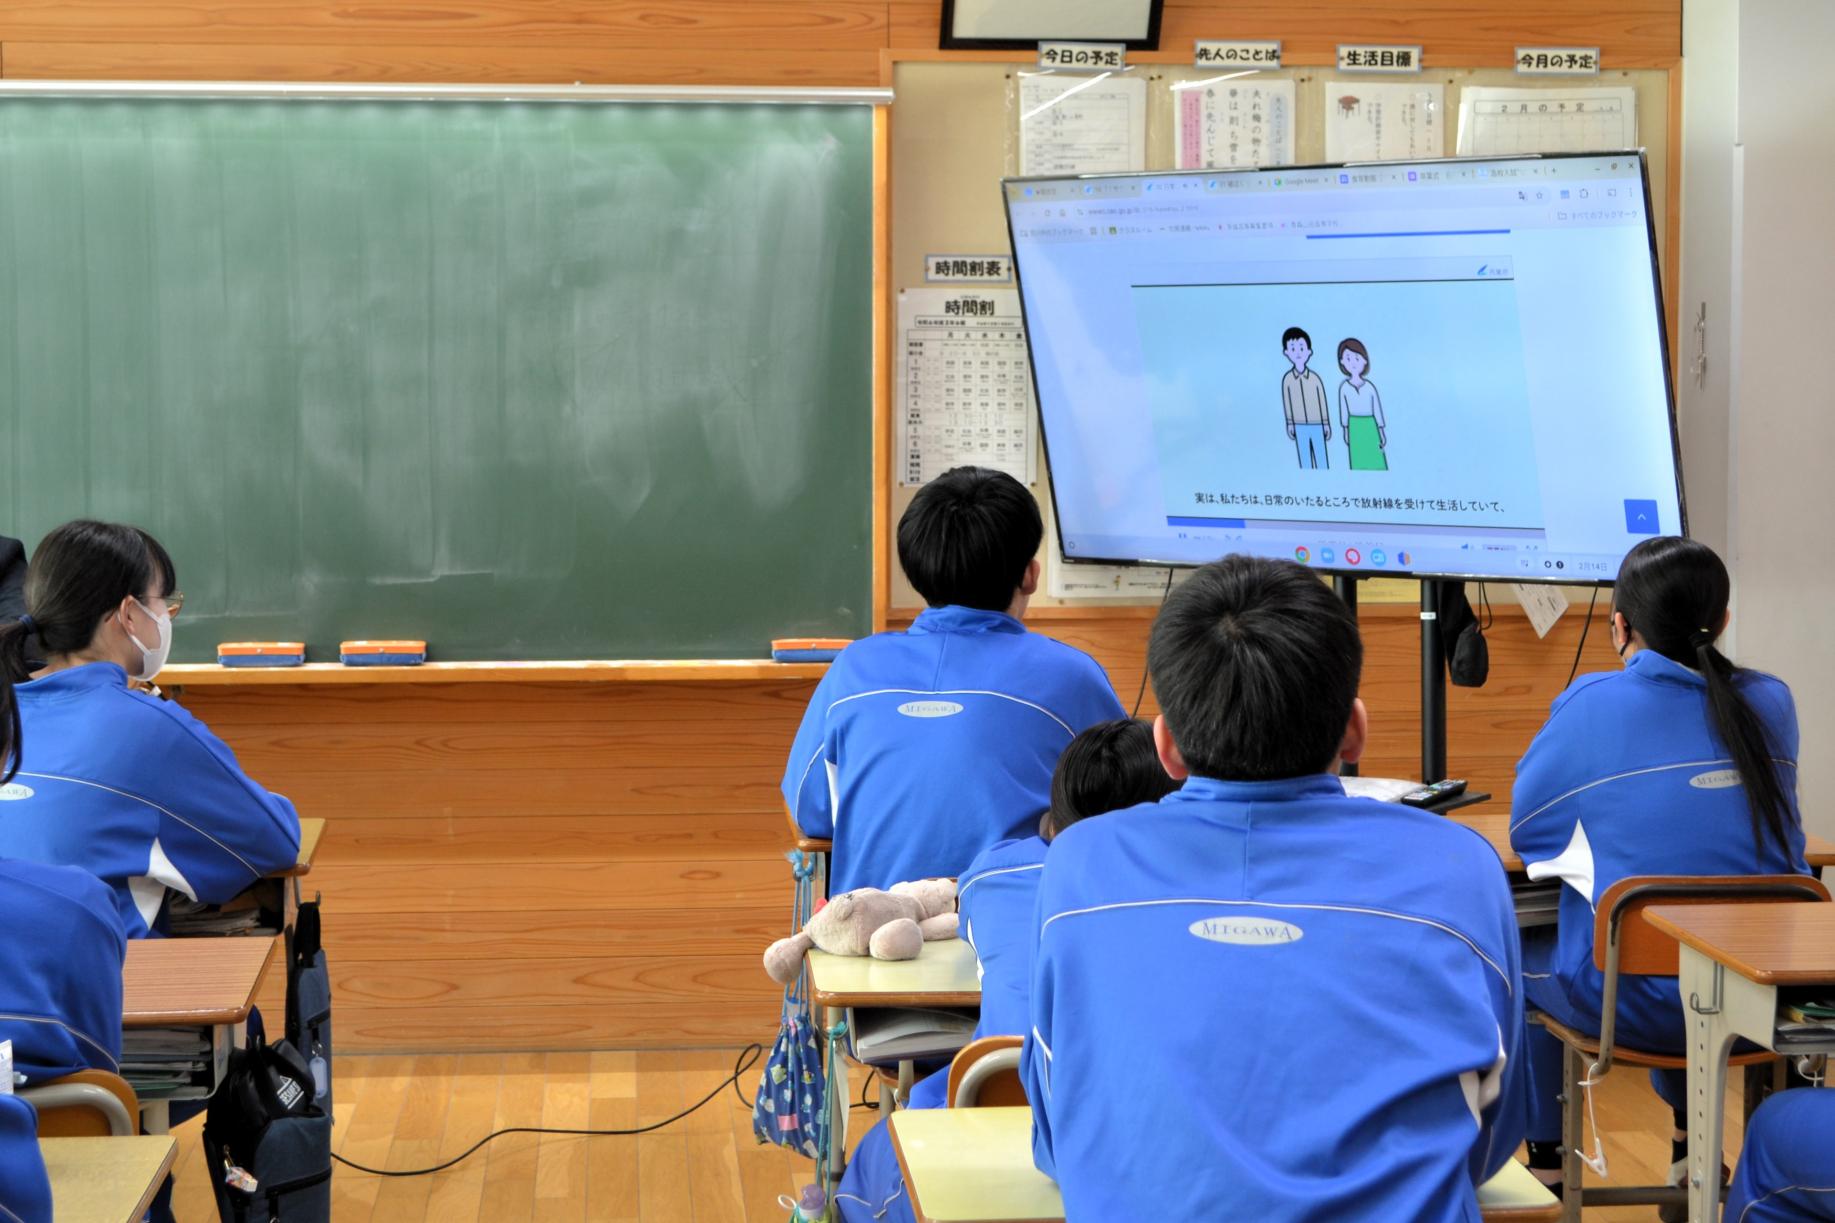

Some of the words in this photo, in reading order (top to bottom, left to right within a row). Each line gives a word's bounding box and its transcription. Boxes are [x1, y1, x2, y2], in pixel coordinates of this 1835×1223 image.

[1045, 48, 1119, 67] 今日の予定
[1198, 48, 1278, 62] 先人のことば
[1346, 50, 1412, 67] 生活目標
[1519, 53, 1593, 68] 今月の予定
[935, 260, 1002, 278] 時間割表
[945, 299, 995, 316] 時間割
[1194, 492, 1506, 513] 実は、私たちは、日常のいたるところで放射線を受けて生活していて、
[1203, 920, 1293, 940] MIGAWA
